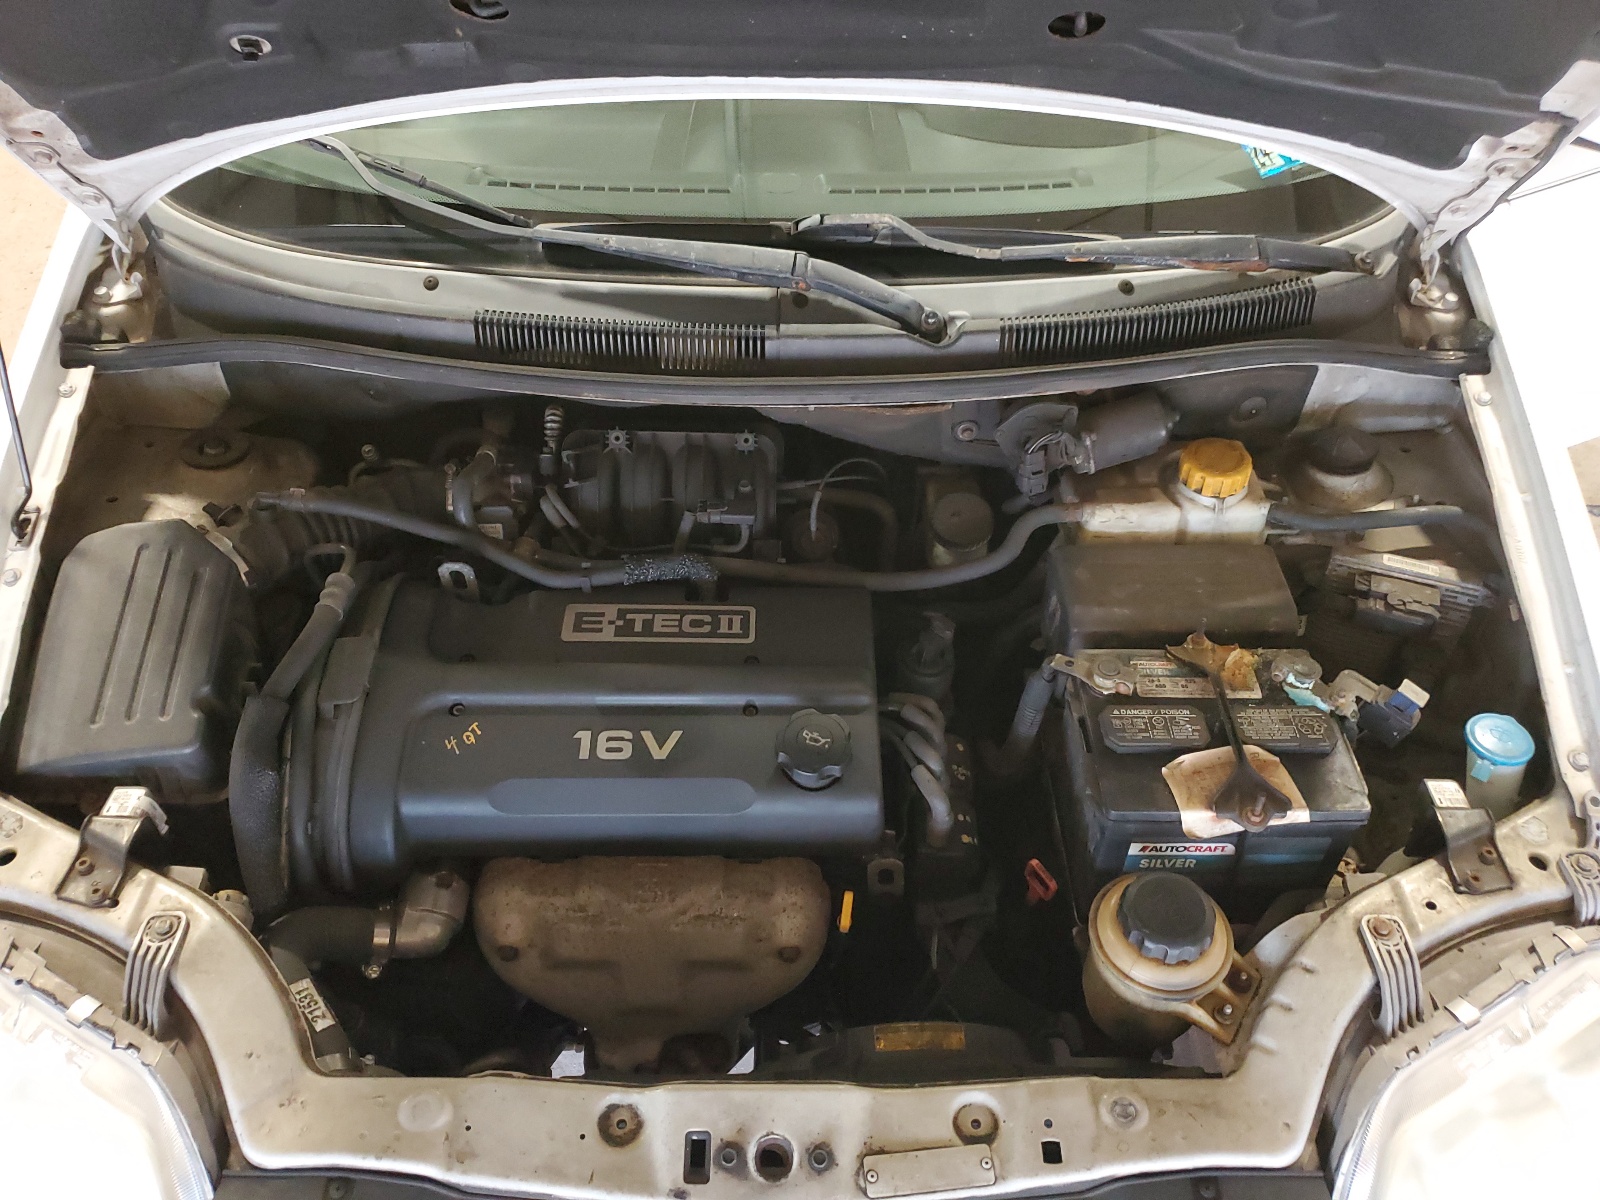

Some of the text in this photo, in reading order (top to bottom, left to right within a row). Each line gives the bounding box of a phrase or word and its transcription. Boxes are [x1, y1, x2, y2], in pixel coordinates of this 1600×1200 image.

[717, 615, 744, 634] II
[1148, 845, 1228, 853] AUTOCRAFT
[1139, 859, 1197, 868] SILVER
